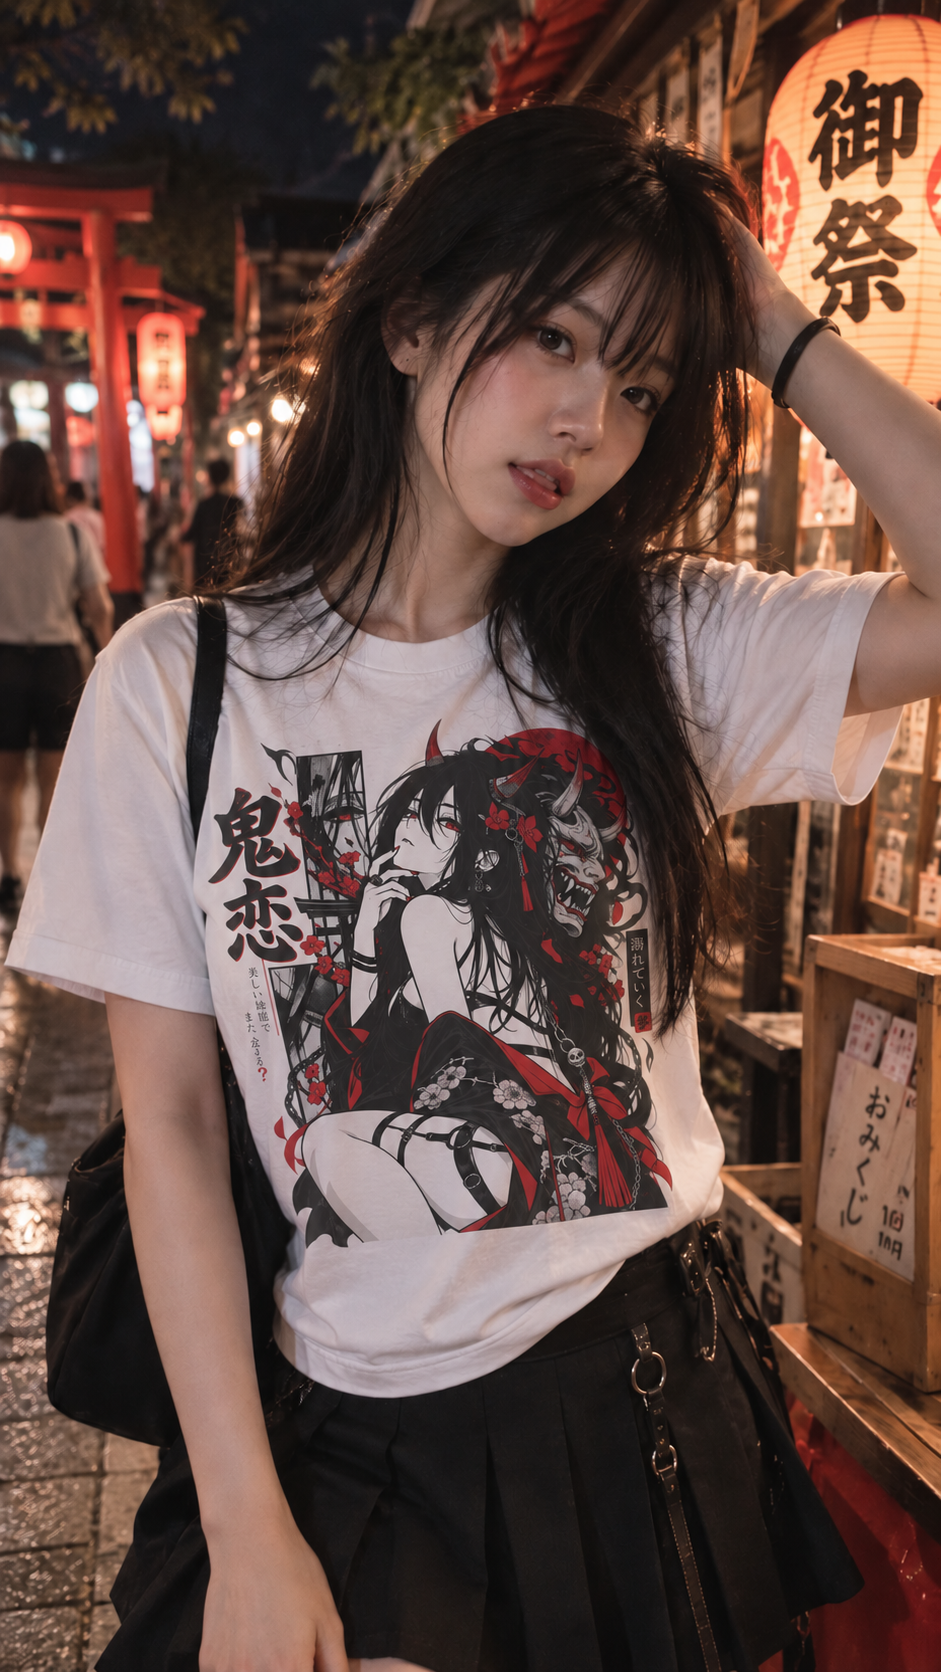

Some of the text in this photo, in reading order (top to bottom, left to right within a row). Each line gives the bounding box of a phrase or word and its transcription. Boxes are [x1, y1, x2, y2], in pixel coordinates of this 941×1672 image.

[808, 69, 923, 323] 御祭
[208, 787, 303, 962] 鬼恋
[846, 1086, 890, 1226] おみくじ
